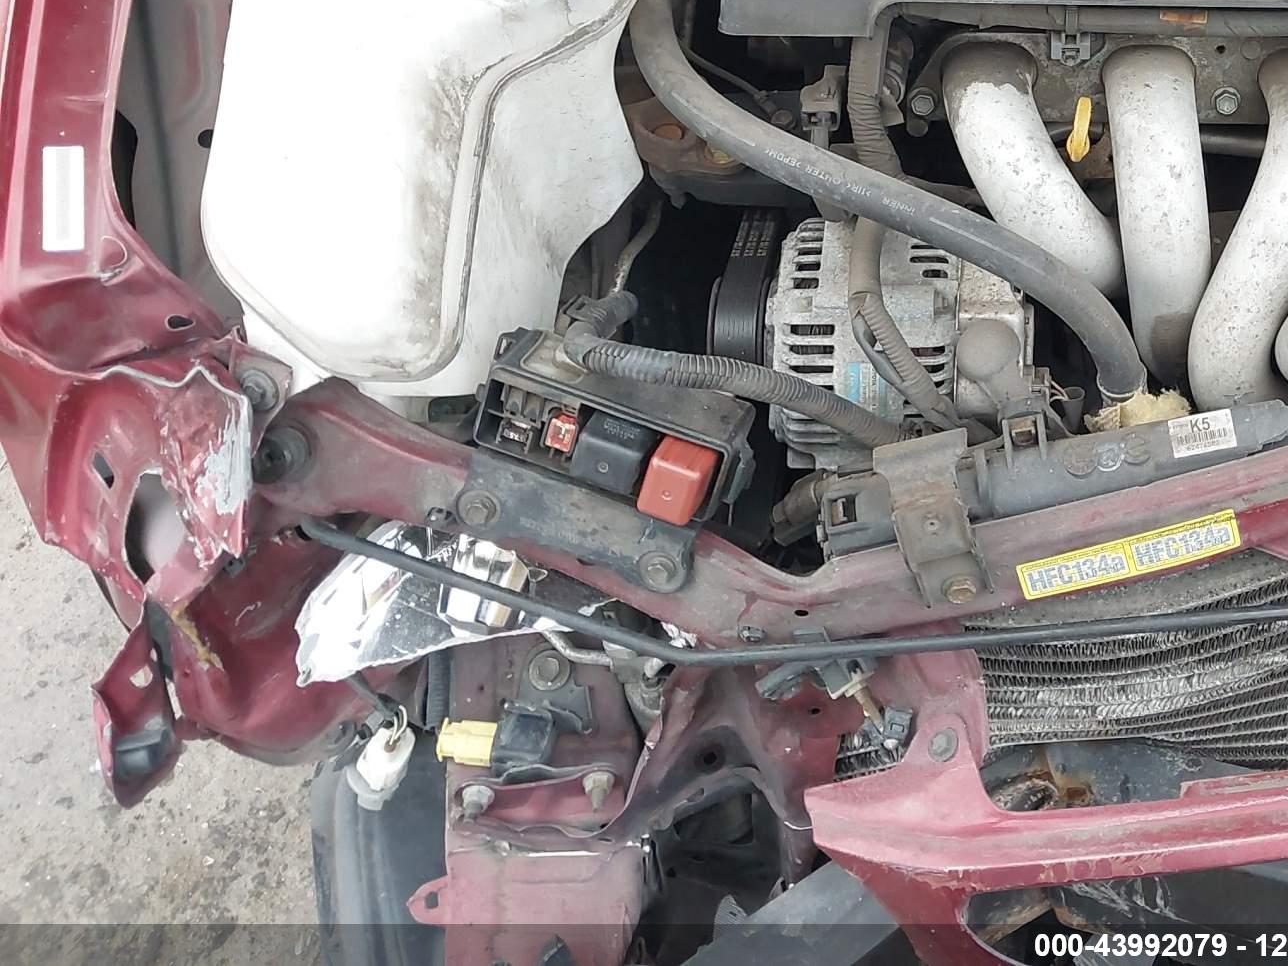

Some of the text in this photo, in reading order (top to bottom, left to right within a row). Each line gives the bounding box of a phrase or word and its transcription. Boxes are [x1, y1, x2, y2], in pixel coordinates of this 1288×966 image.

[1189, 416, 1211, 434] K5
[1134, 522, 1232, 567] HFC134a
[1026, 552, 1126, 593] HFC134a
